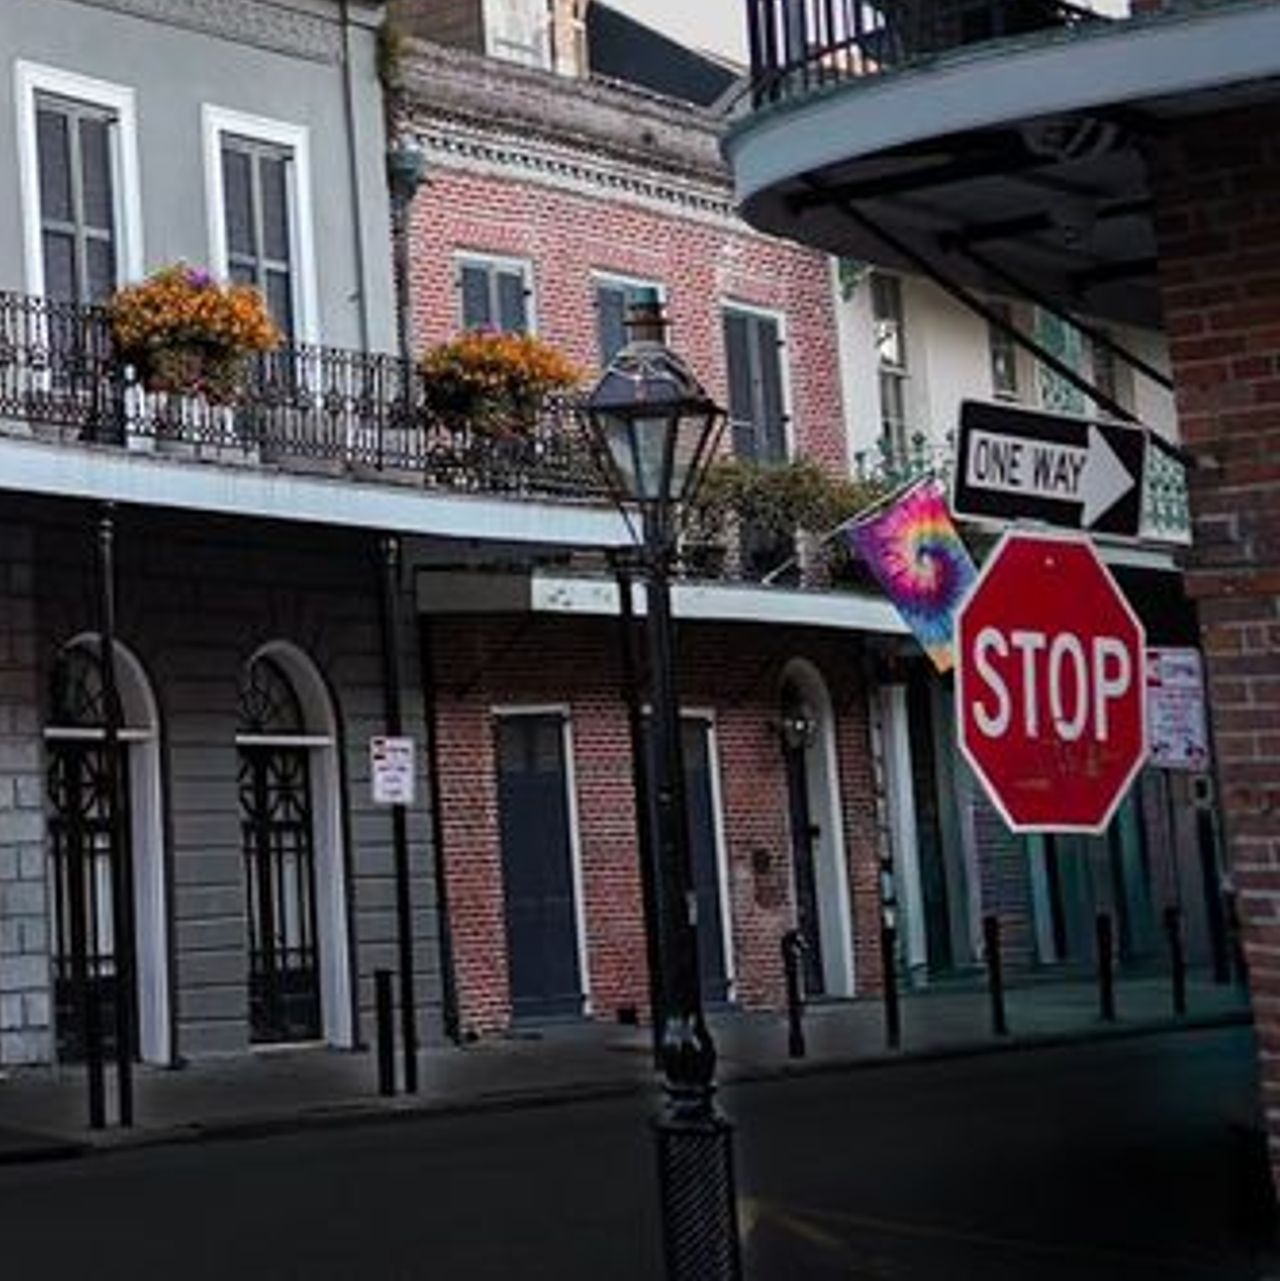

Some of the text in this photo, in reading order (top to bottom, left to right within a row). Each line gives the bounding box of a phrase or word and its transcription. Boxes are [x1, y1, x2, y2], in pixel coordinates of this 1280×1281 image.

[973, 438, 1086, 495] ONE WAY
[972, 626, 1132, 742] STOP
